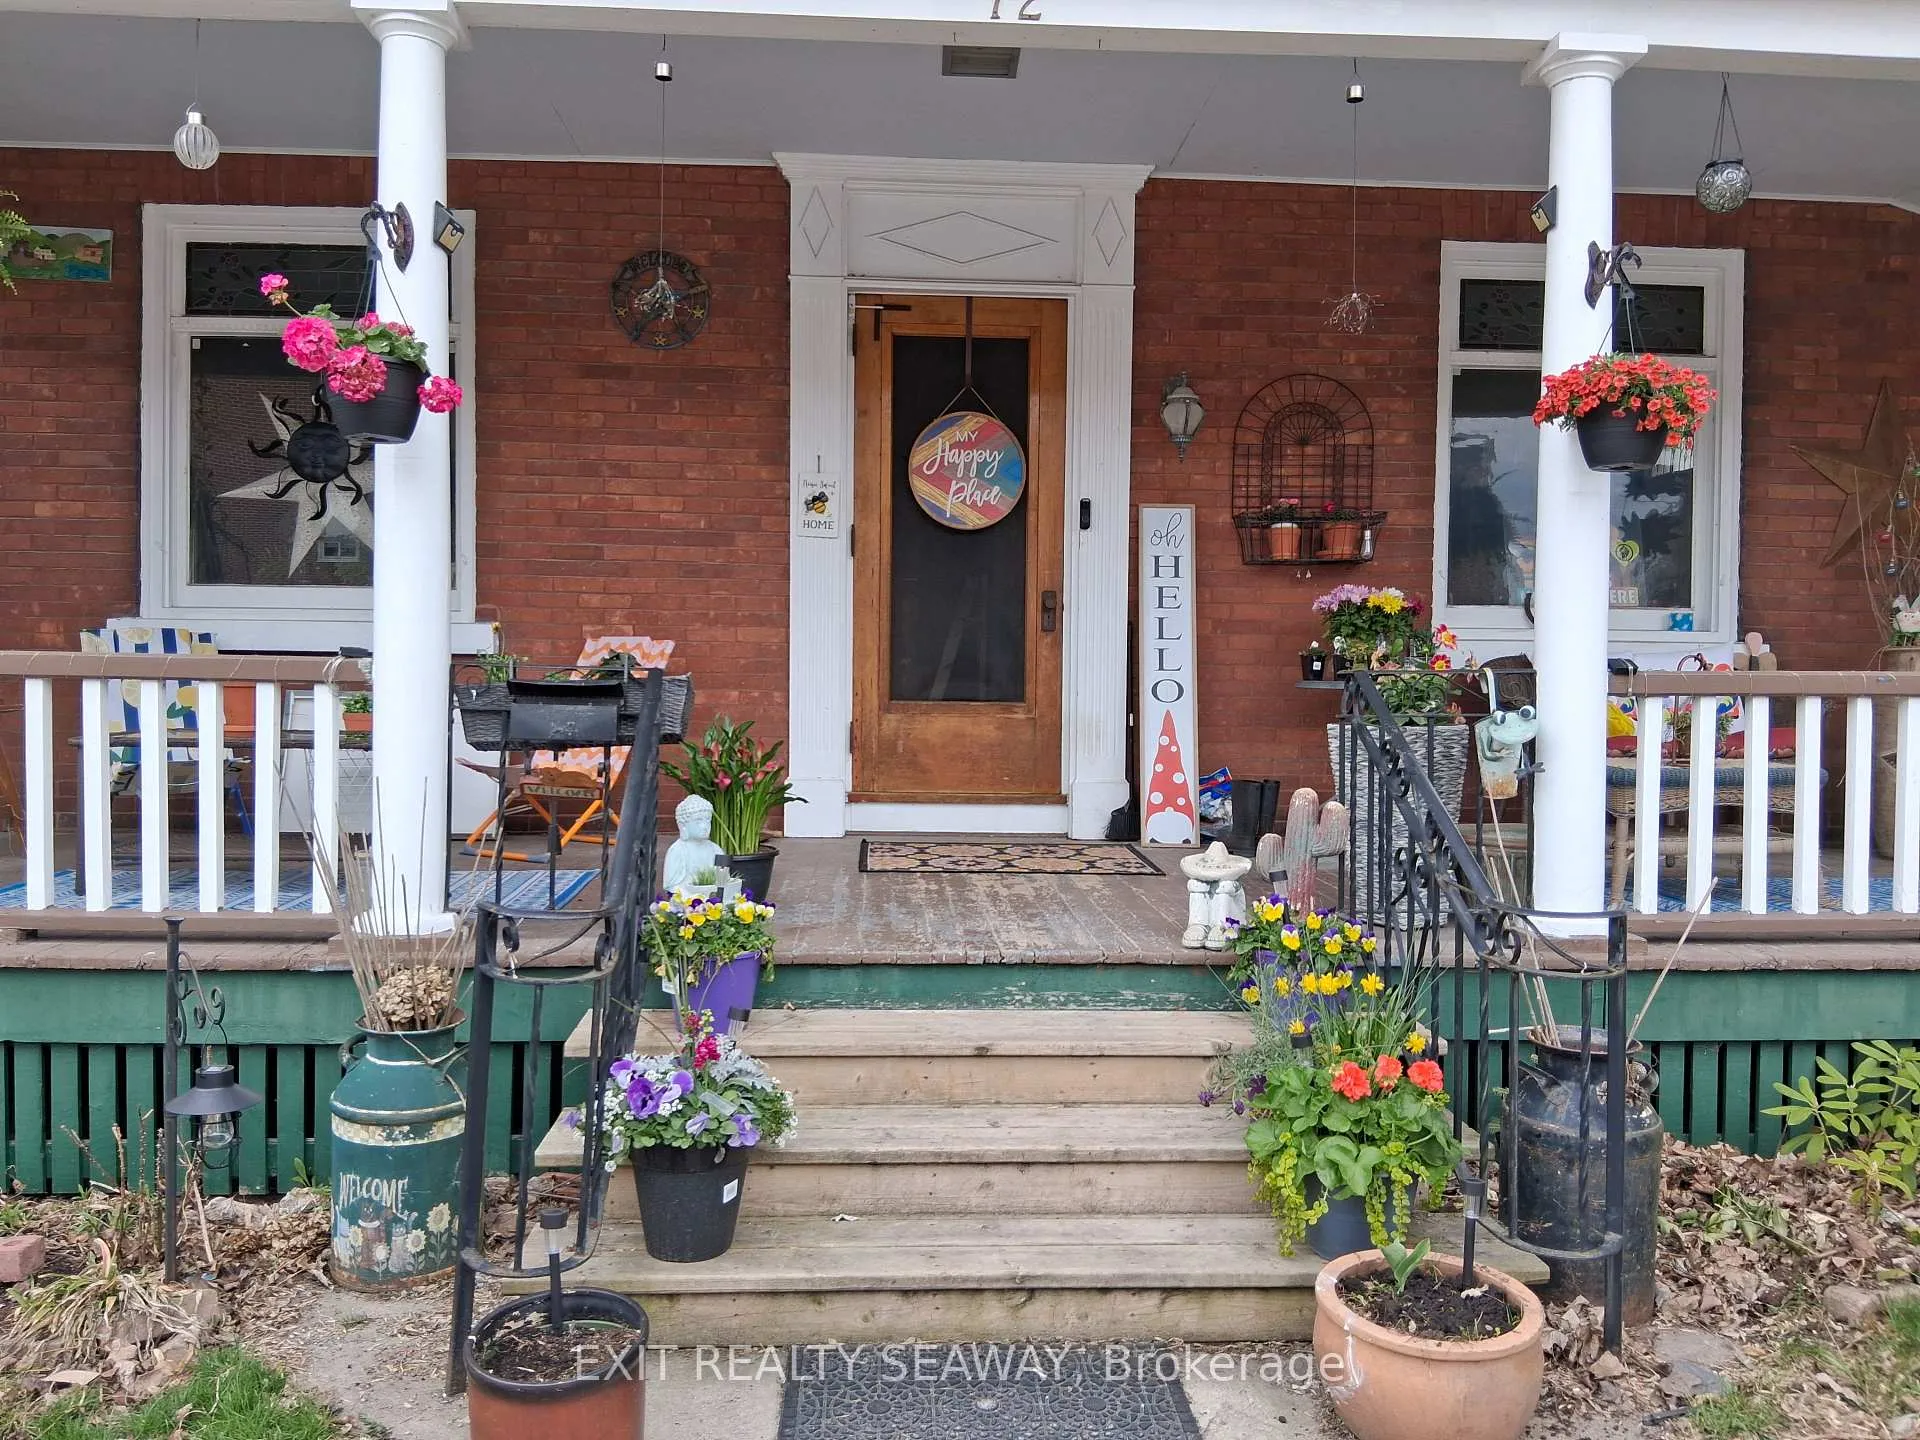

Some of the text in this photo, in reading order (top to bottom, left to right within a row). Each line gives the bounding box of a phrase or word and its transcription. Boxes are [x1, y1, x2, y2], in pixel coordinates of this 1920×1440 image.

[956, 431, 978, 442] MY
[923, 438, 1004, 478] Happy
[803, 520, 834, 530] HOME
[1150, 512, 1185, 549] oh
[1609, 589, 1638, 604] ERE
[1150, 555, 1185, 704] HELLO
[339, 1171, 409, 1219] WELCOME
